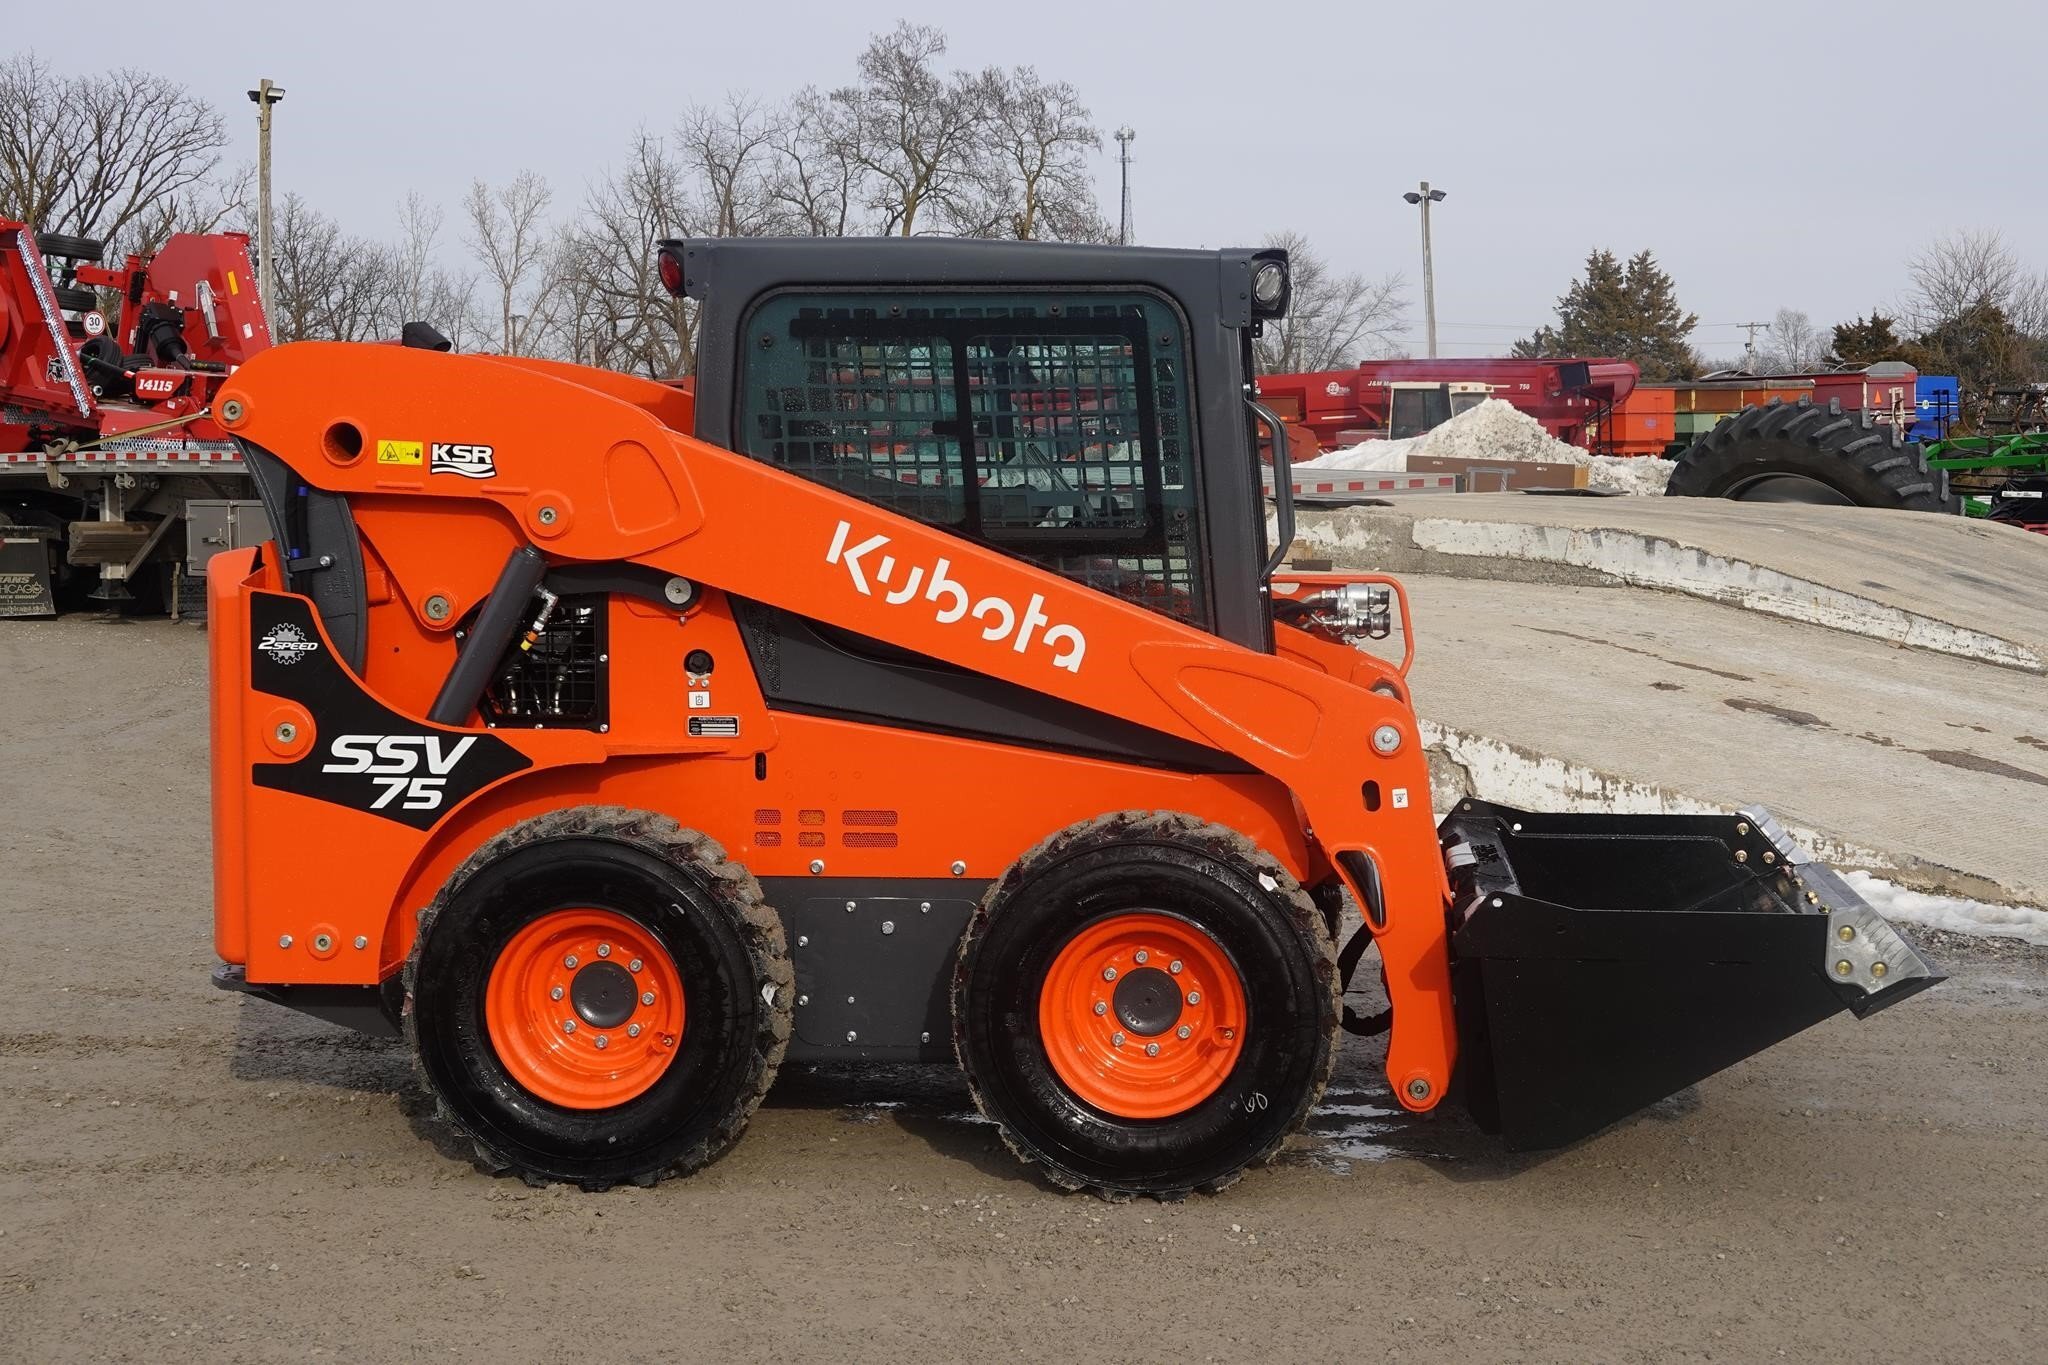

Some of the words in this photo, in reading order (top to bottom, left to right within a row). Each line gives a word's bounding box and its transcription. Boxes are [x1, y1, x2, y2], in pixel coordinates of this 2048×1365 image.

[89, 317, 101, 327] 30
[138, 379, 173, 392] 14115
[431, 443, 493, 463] KSR
[826, 520, 1087, 674] Kubota
[322, 734, 478, 775] SSV
[369, 777, 447, 810] 75
